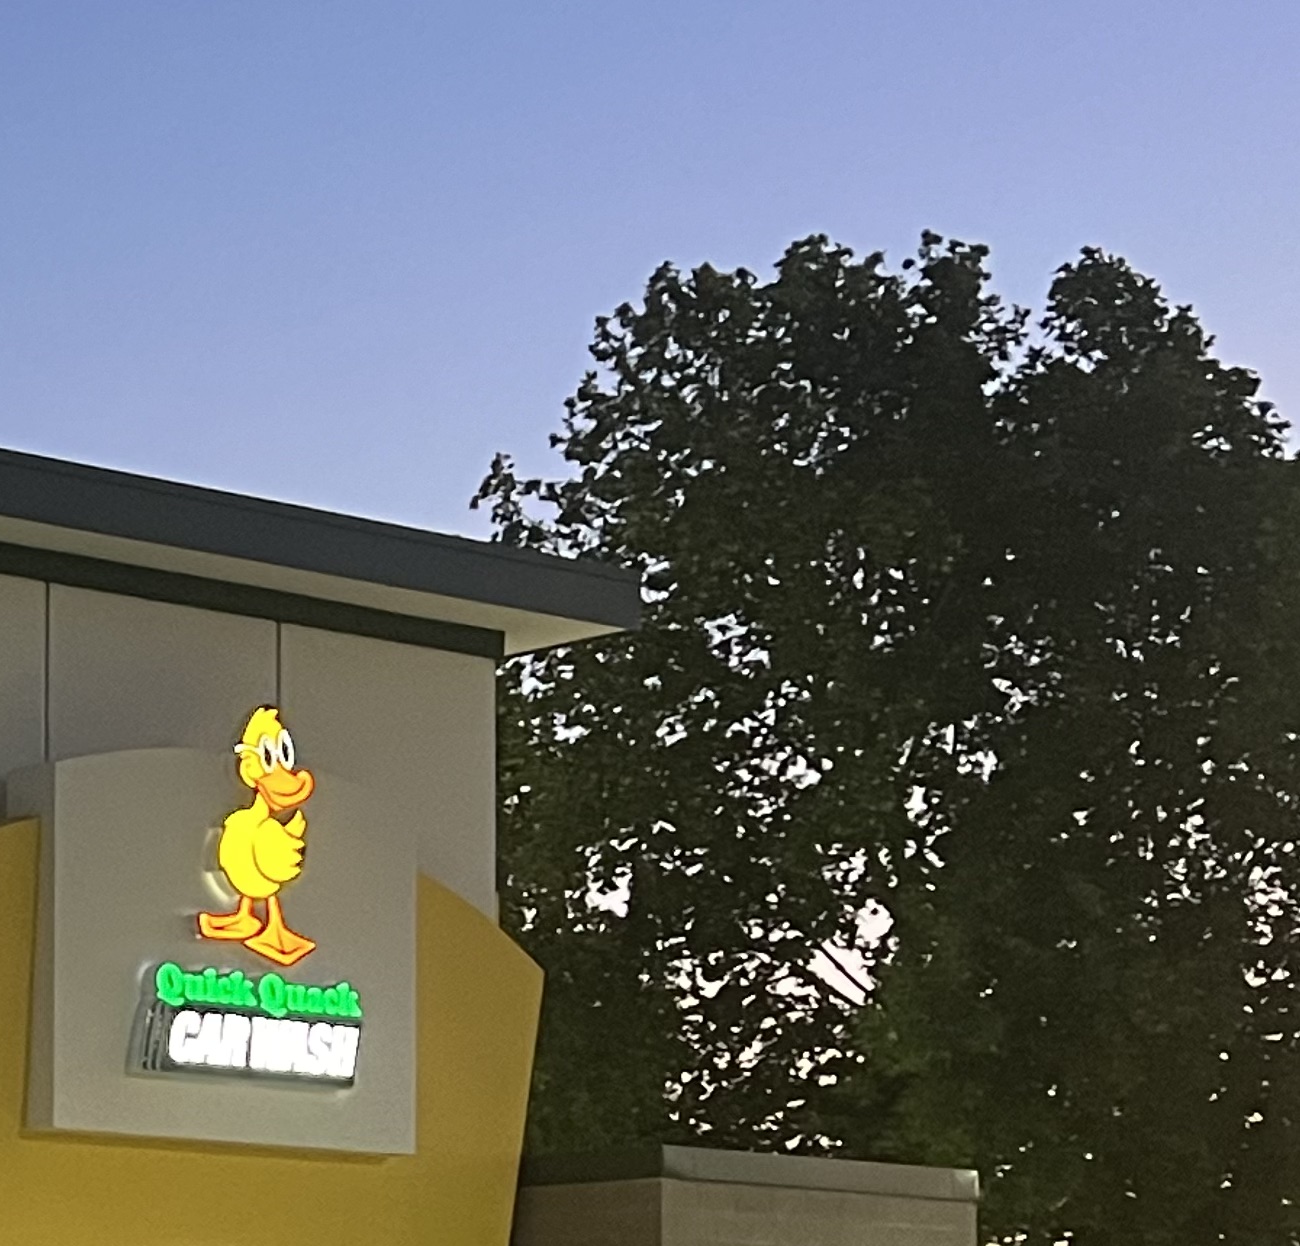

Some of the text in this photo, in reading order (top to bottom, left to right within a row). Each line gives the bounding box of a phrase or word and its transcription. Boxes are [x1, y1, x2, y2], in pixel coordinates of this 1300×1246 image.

[156, 962, 362, 1018] Quick Quack
[168, 1009, 359, 1078] CAR WASH
